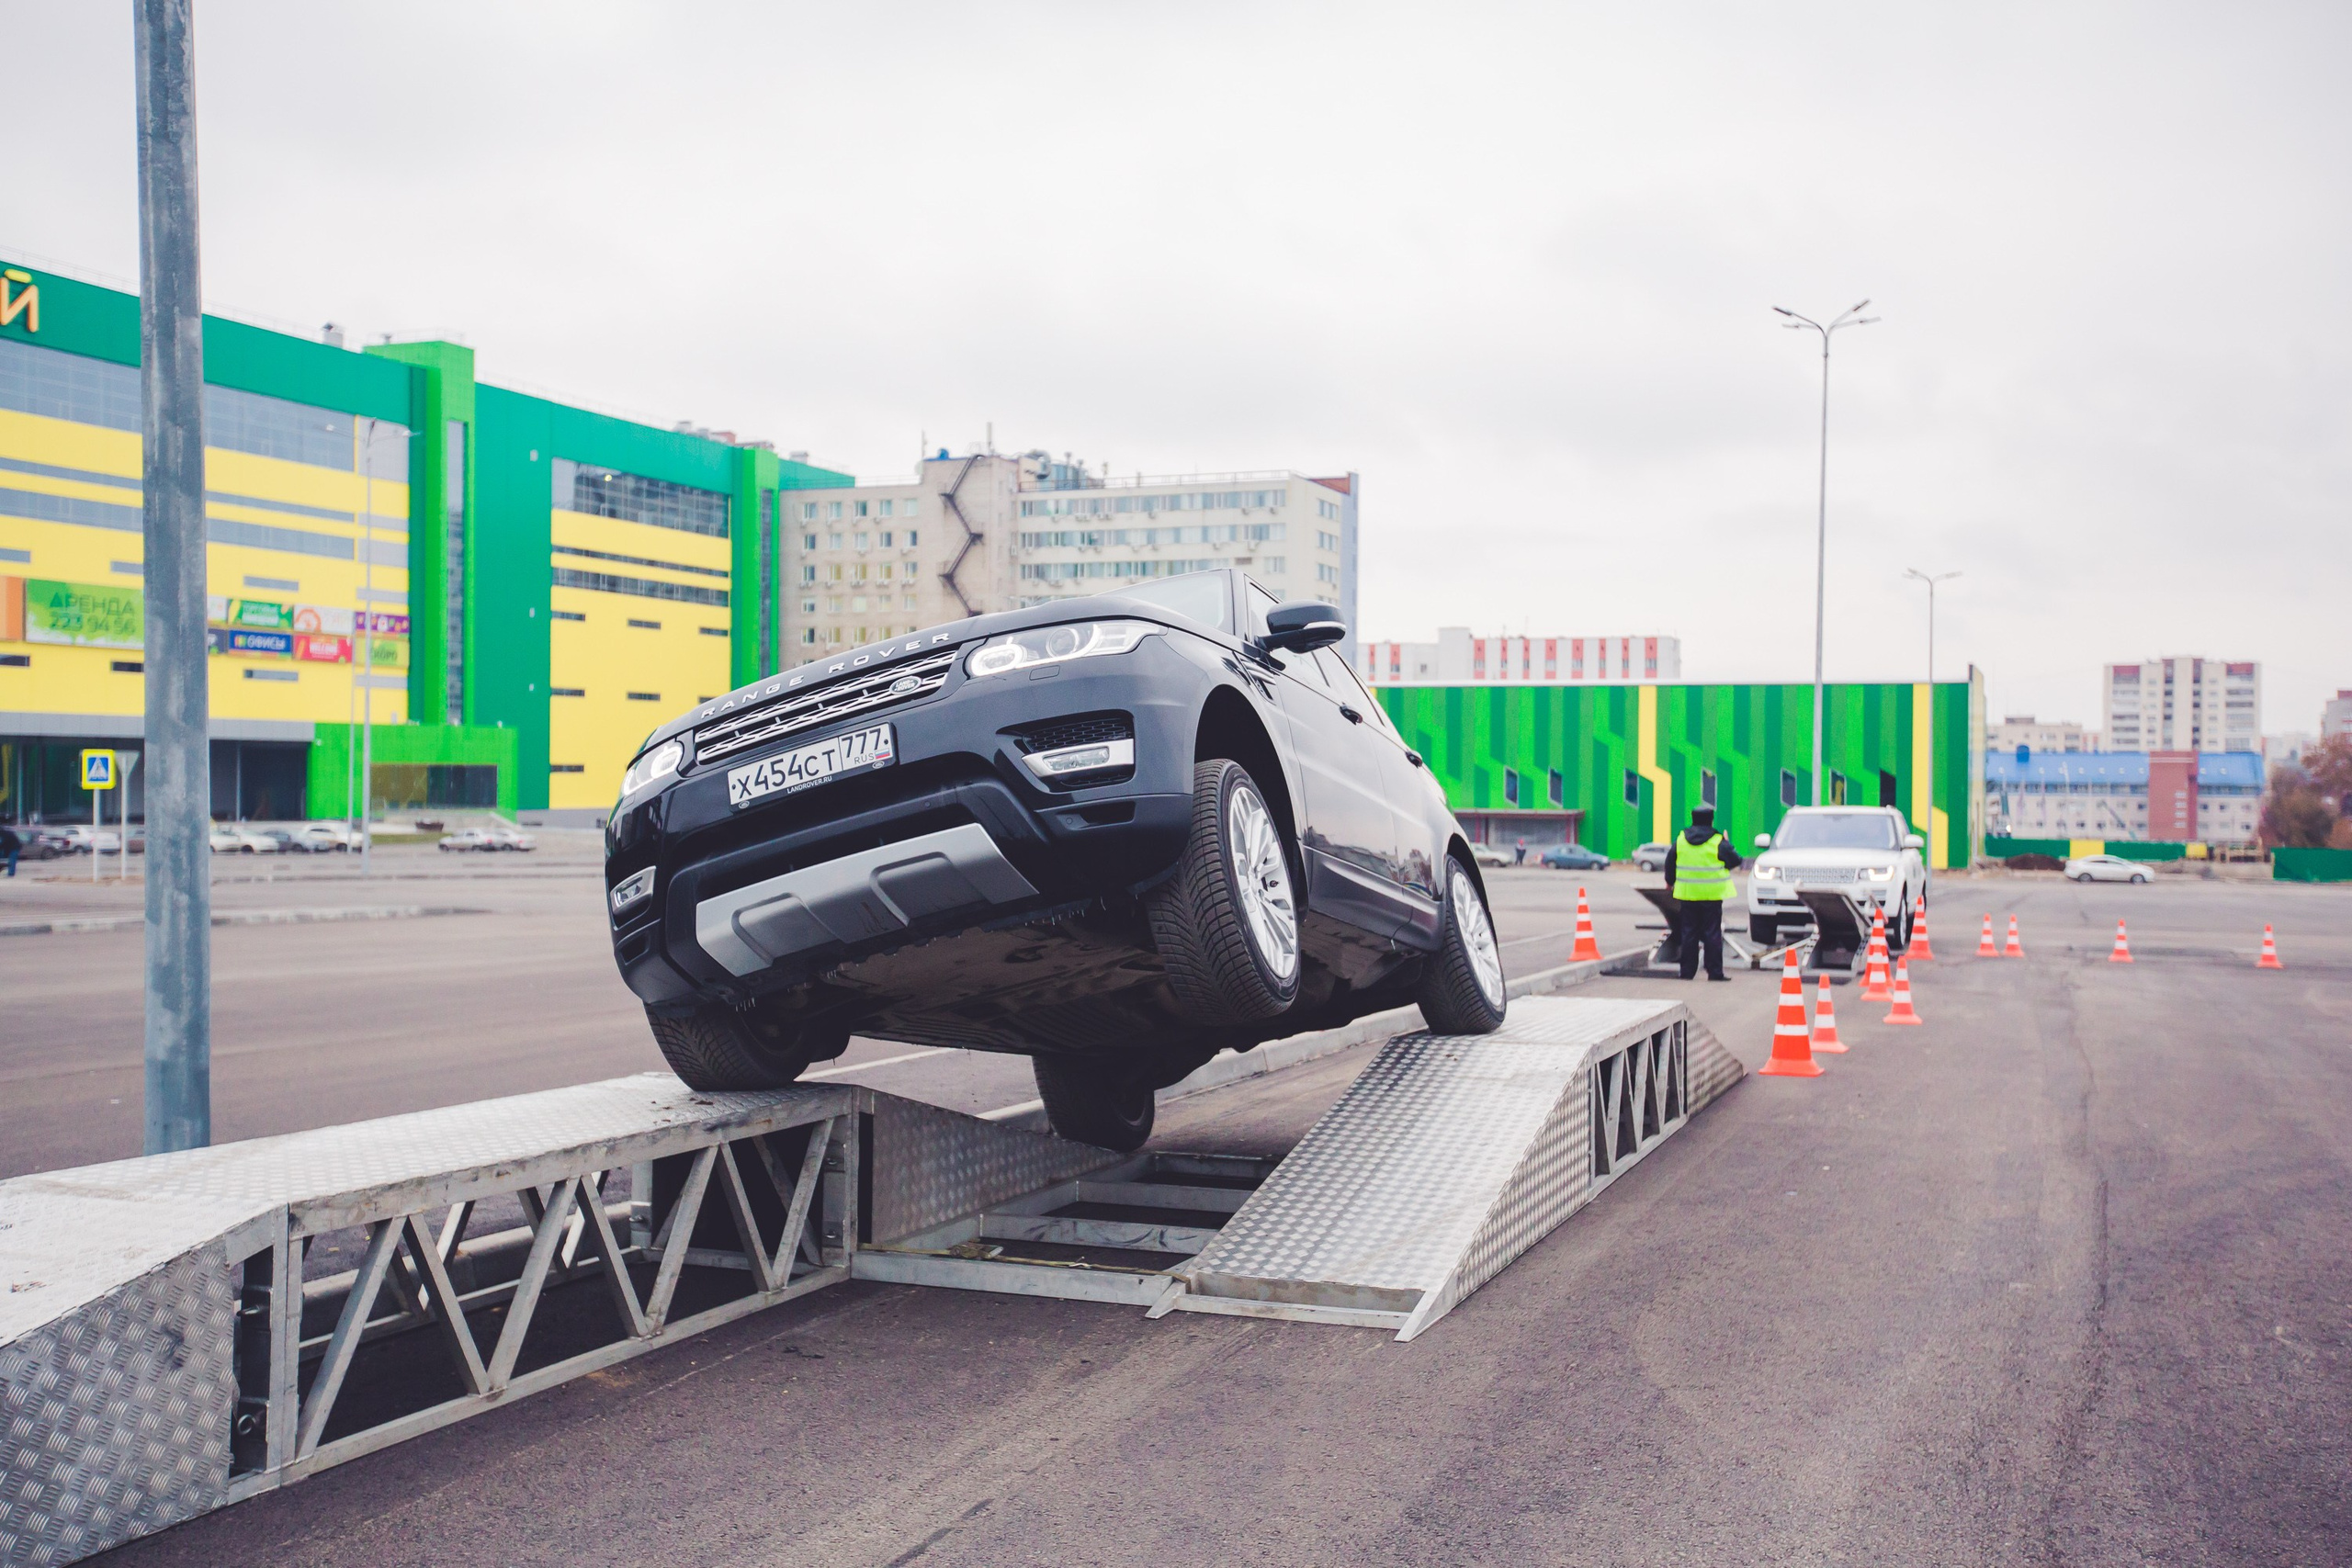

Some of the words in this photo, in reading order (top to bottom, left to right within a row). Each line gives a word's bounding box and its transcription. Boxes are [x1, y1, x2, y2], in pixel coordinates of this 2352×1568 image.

[50, 592, 135, 616] АРЕНДА
[700, 674, 805, 719] RANGE
[828, 632, 950, 674] ROVER
[842, 728, 881, 758] 777
[854, 752, 875, 764] RUS
[786, 775, 832, 794] LANDROVER.RU
